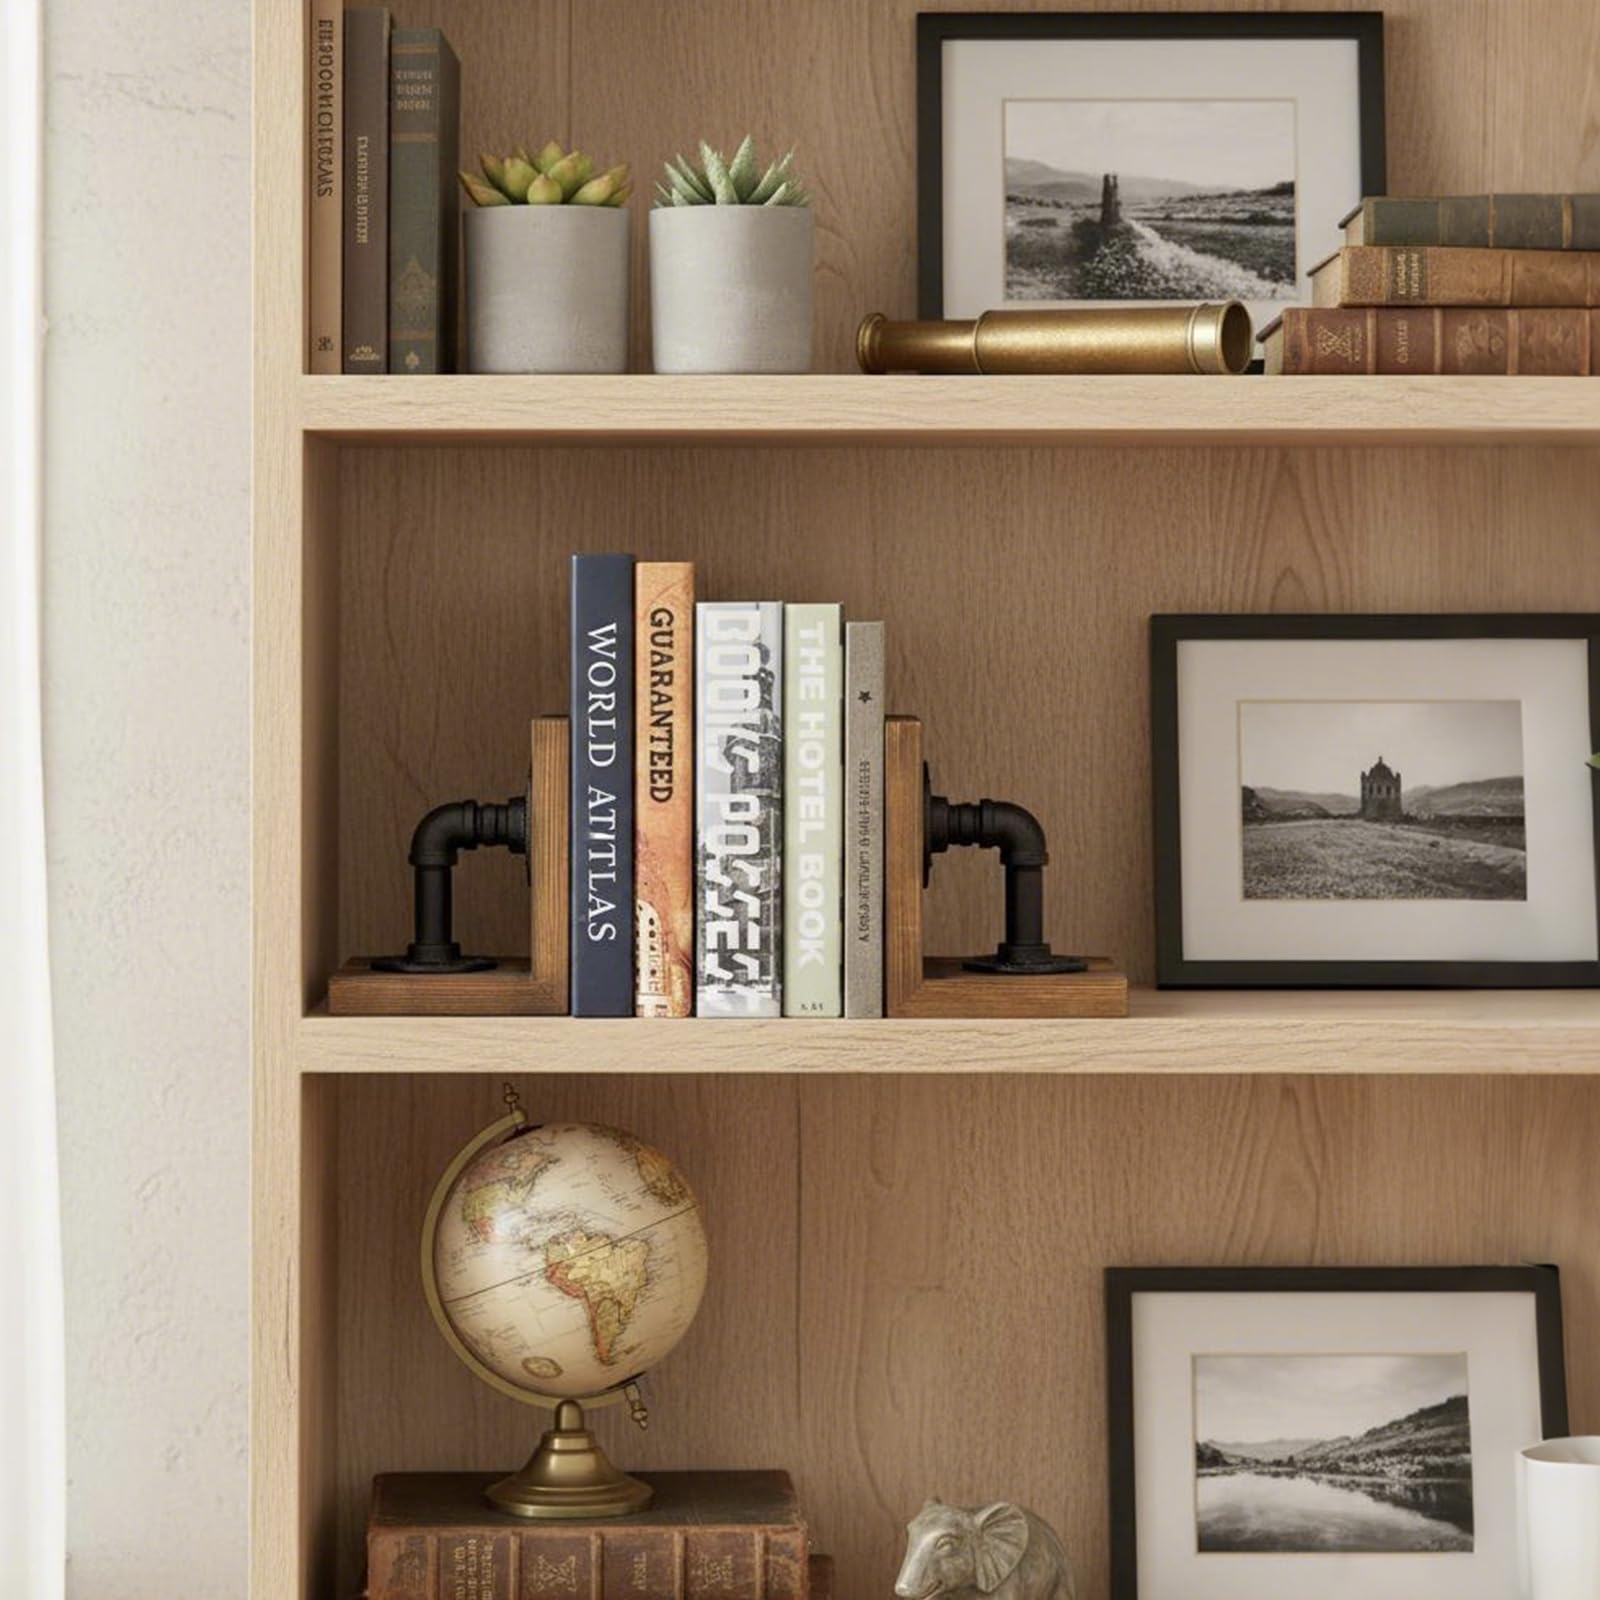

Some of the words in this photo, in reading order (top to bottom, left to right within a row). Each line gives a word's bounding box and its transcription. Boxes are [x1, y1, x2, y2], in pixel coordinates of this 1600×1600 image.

[588, 622, 617, 768] WORLD
[650, 607, 674, 804] GUARANTEED
[799, 621, 825, 701] THE
[799, 711, 825, 844] HOTEL
[799, 853, 825, 969] BOOK
